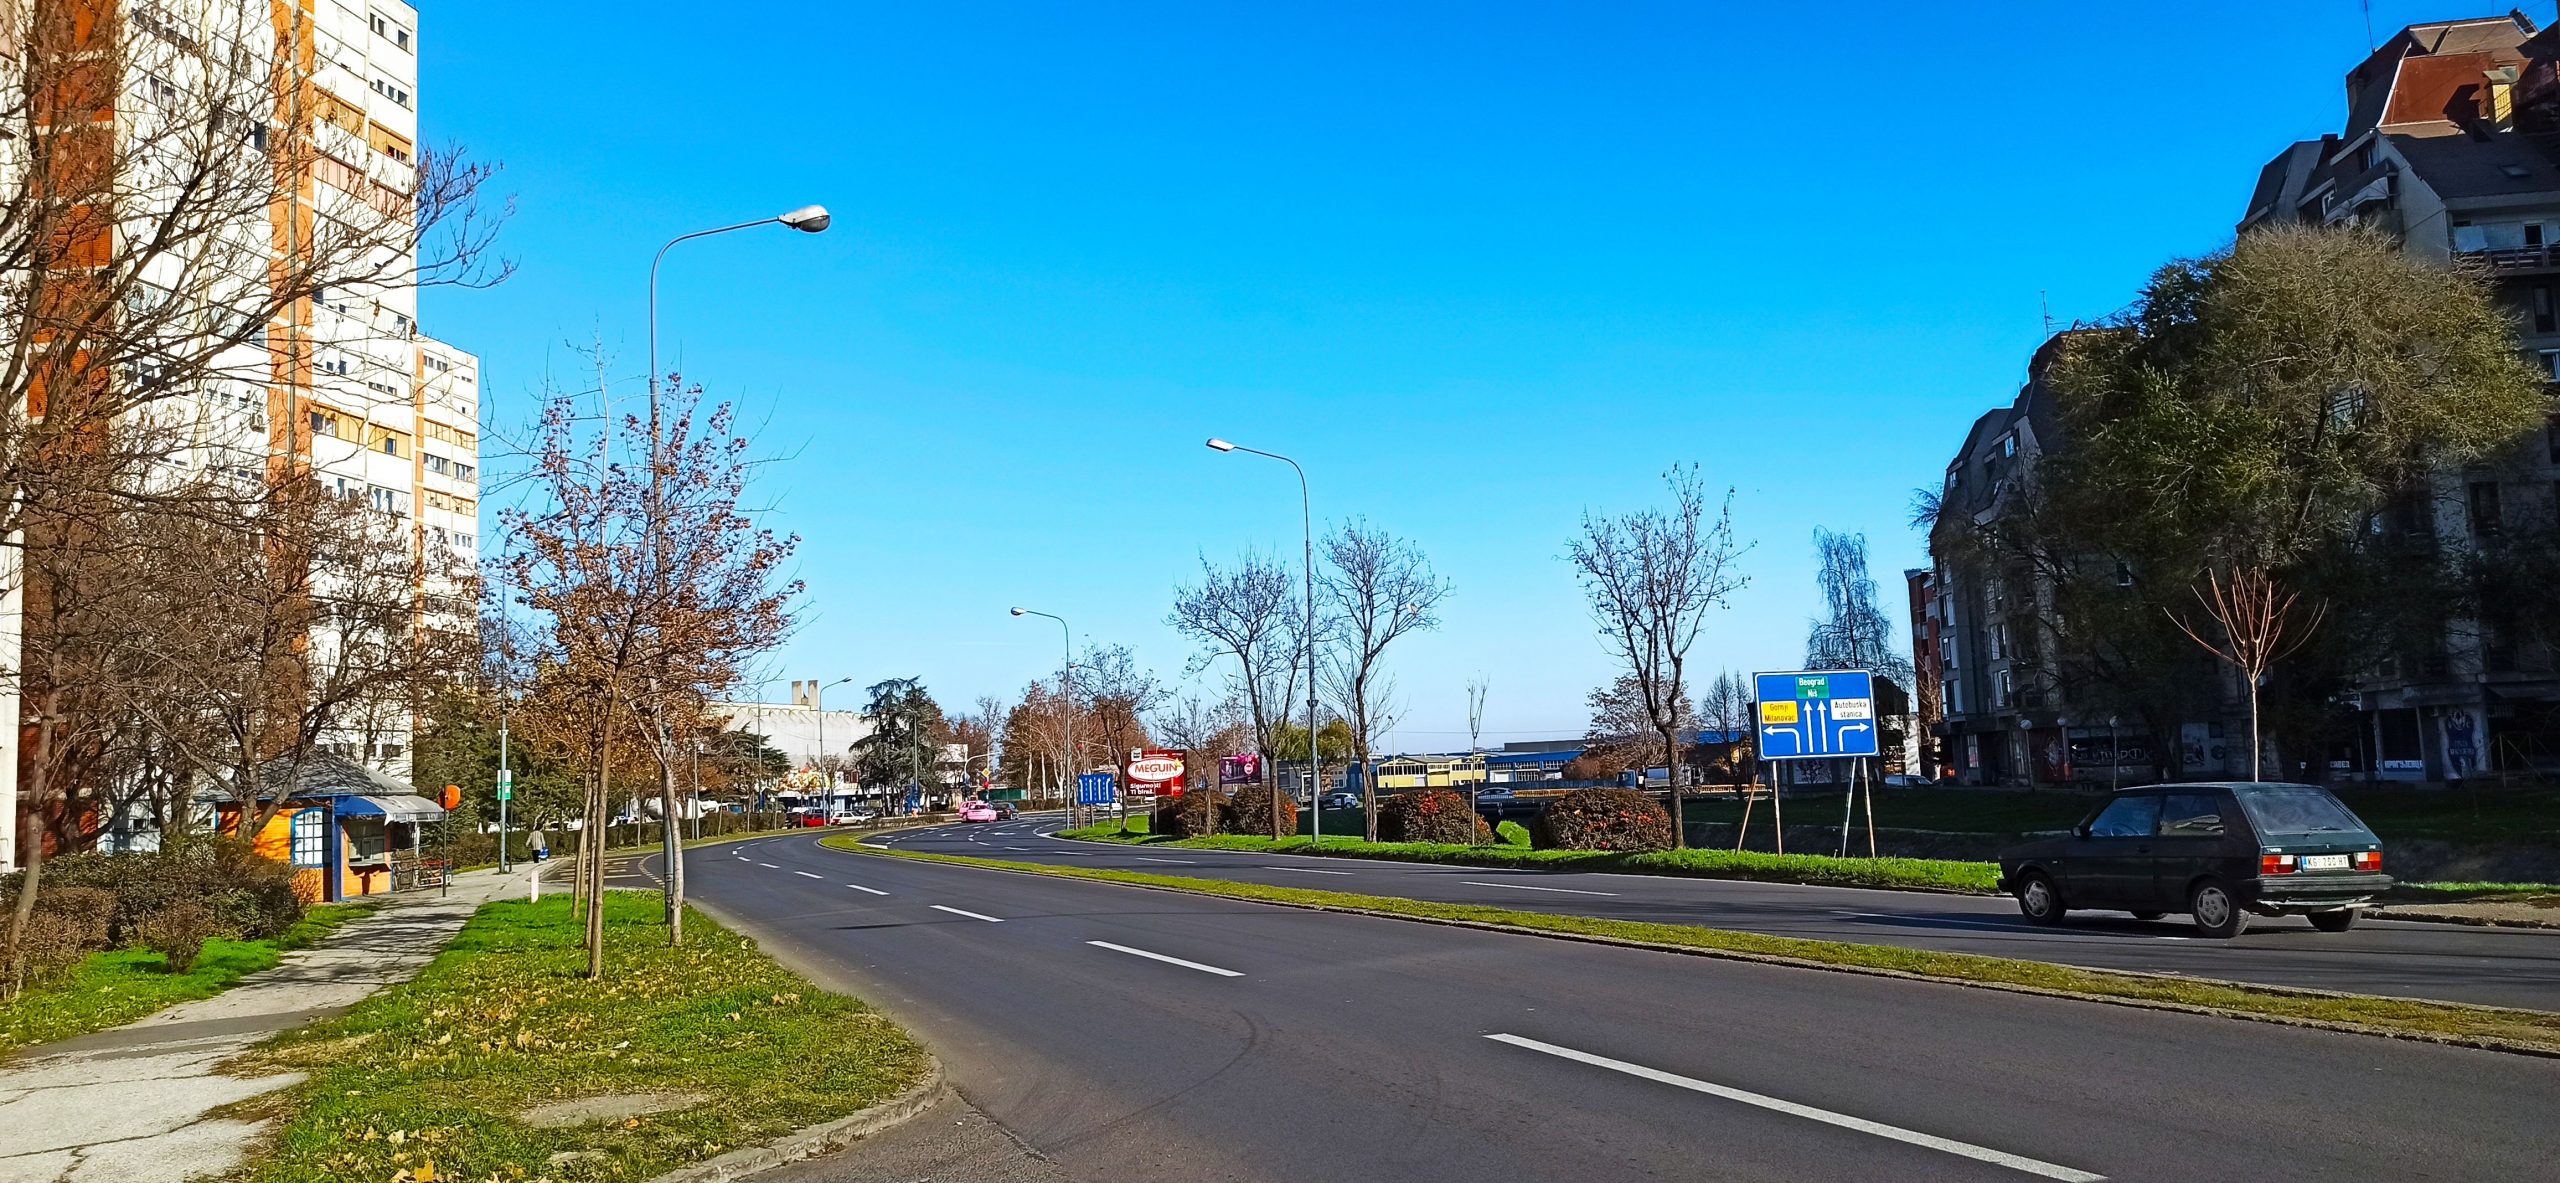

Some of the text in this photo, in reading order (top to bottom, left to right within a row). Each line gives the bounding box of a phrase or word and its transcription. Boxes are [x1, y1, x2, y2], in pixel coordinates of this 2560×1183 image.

[1799, 677, 1825, 687] Beograd
[1769, 703, 1788, 712] Gornji
[1834, 700, 1867, 709] Autobuska
[1764, 713, 1795, 722] Milanovac
[1840, 710, 1863, 718] stanica
[1134, 763, 1178, 773] MEGUIN
[2307, 857, 2318, 867] KG
